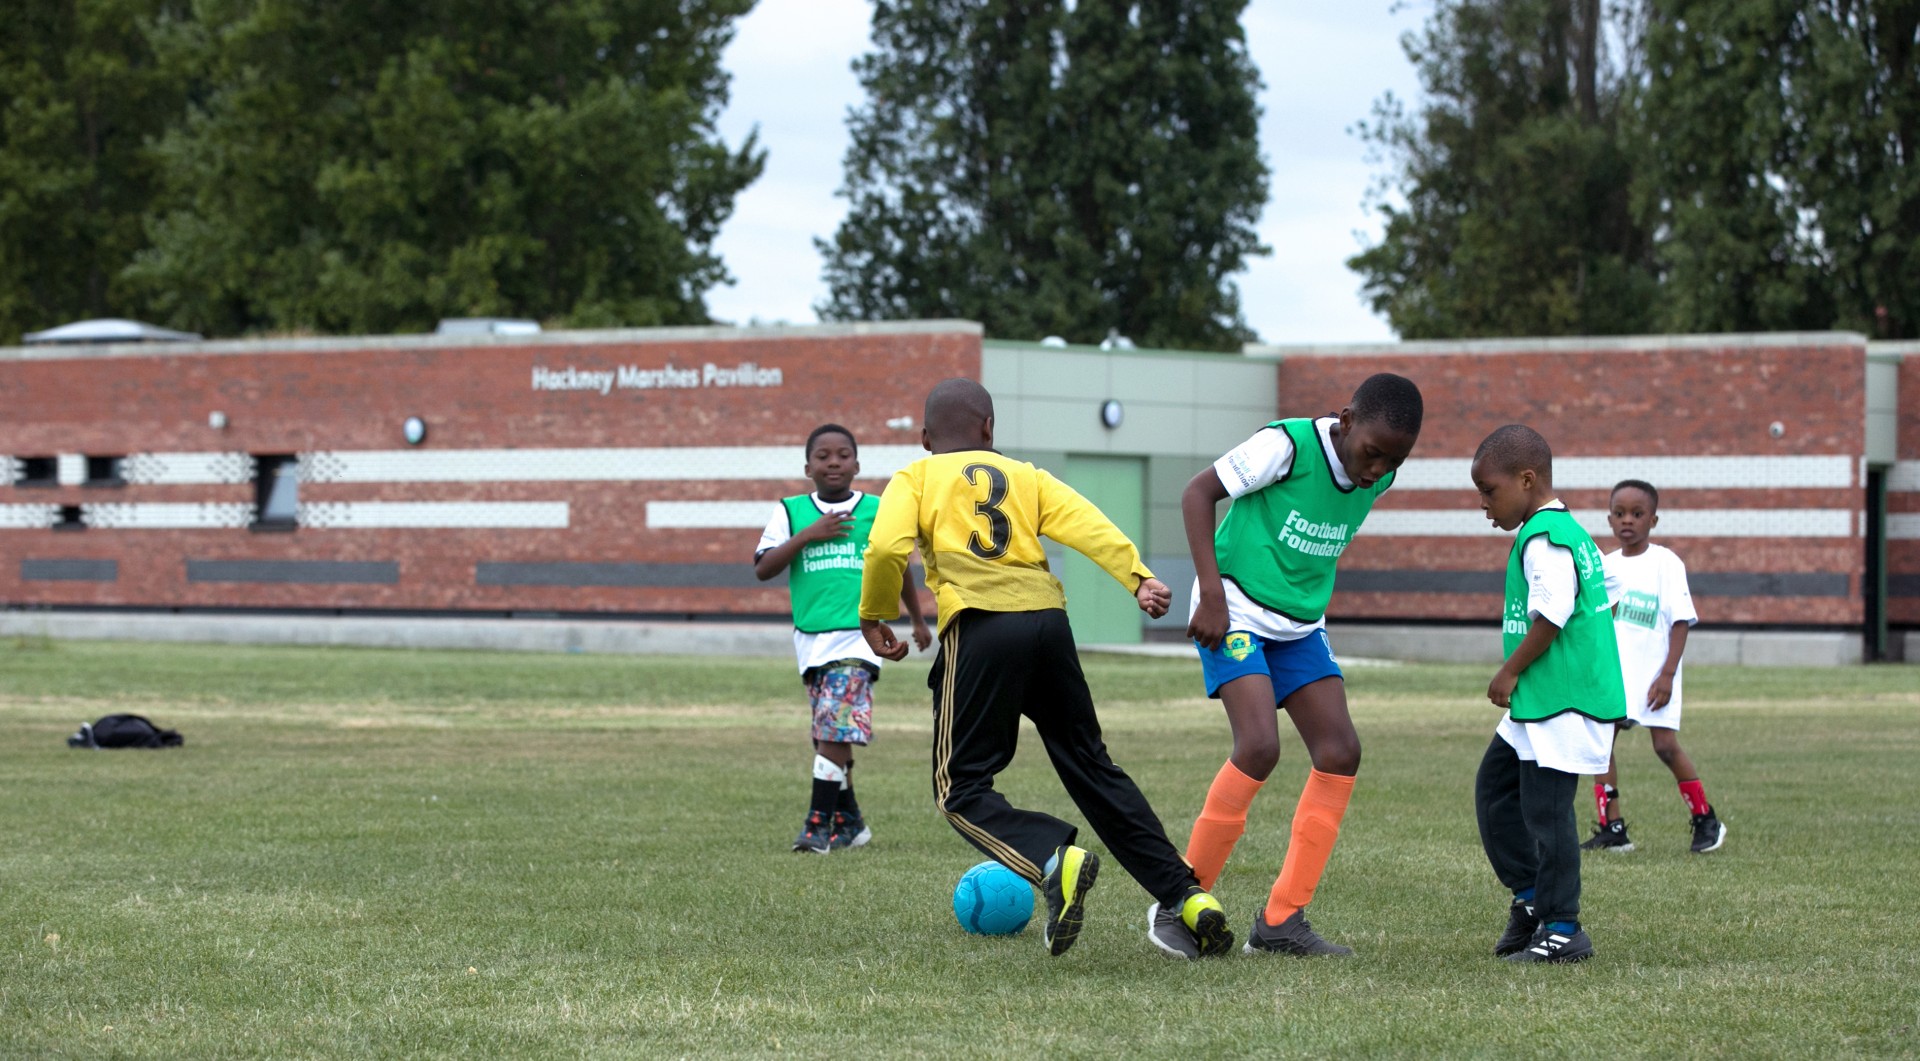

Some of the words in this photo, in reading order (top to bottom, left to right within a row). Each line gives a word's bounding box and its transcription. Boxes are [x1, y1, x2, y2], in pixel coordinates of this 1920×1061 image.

[531, 365, 614, 395] Hackney
[616, 363, 700, 388] Marshes
[702, 362, 783, 387] Pavilion
[962, 462, 1012, 560] 3
[1285, 509, 1348, 540] Football
[802, 542, 855, 559] Football
[1278, 525, 1347, 557] Foundati
[803, 555, 864, 573] Foundatio
[1622, 604, 1655, 625] Fund
